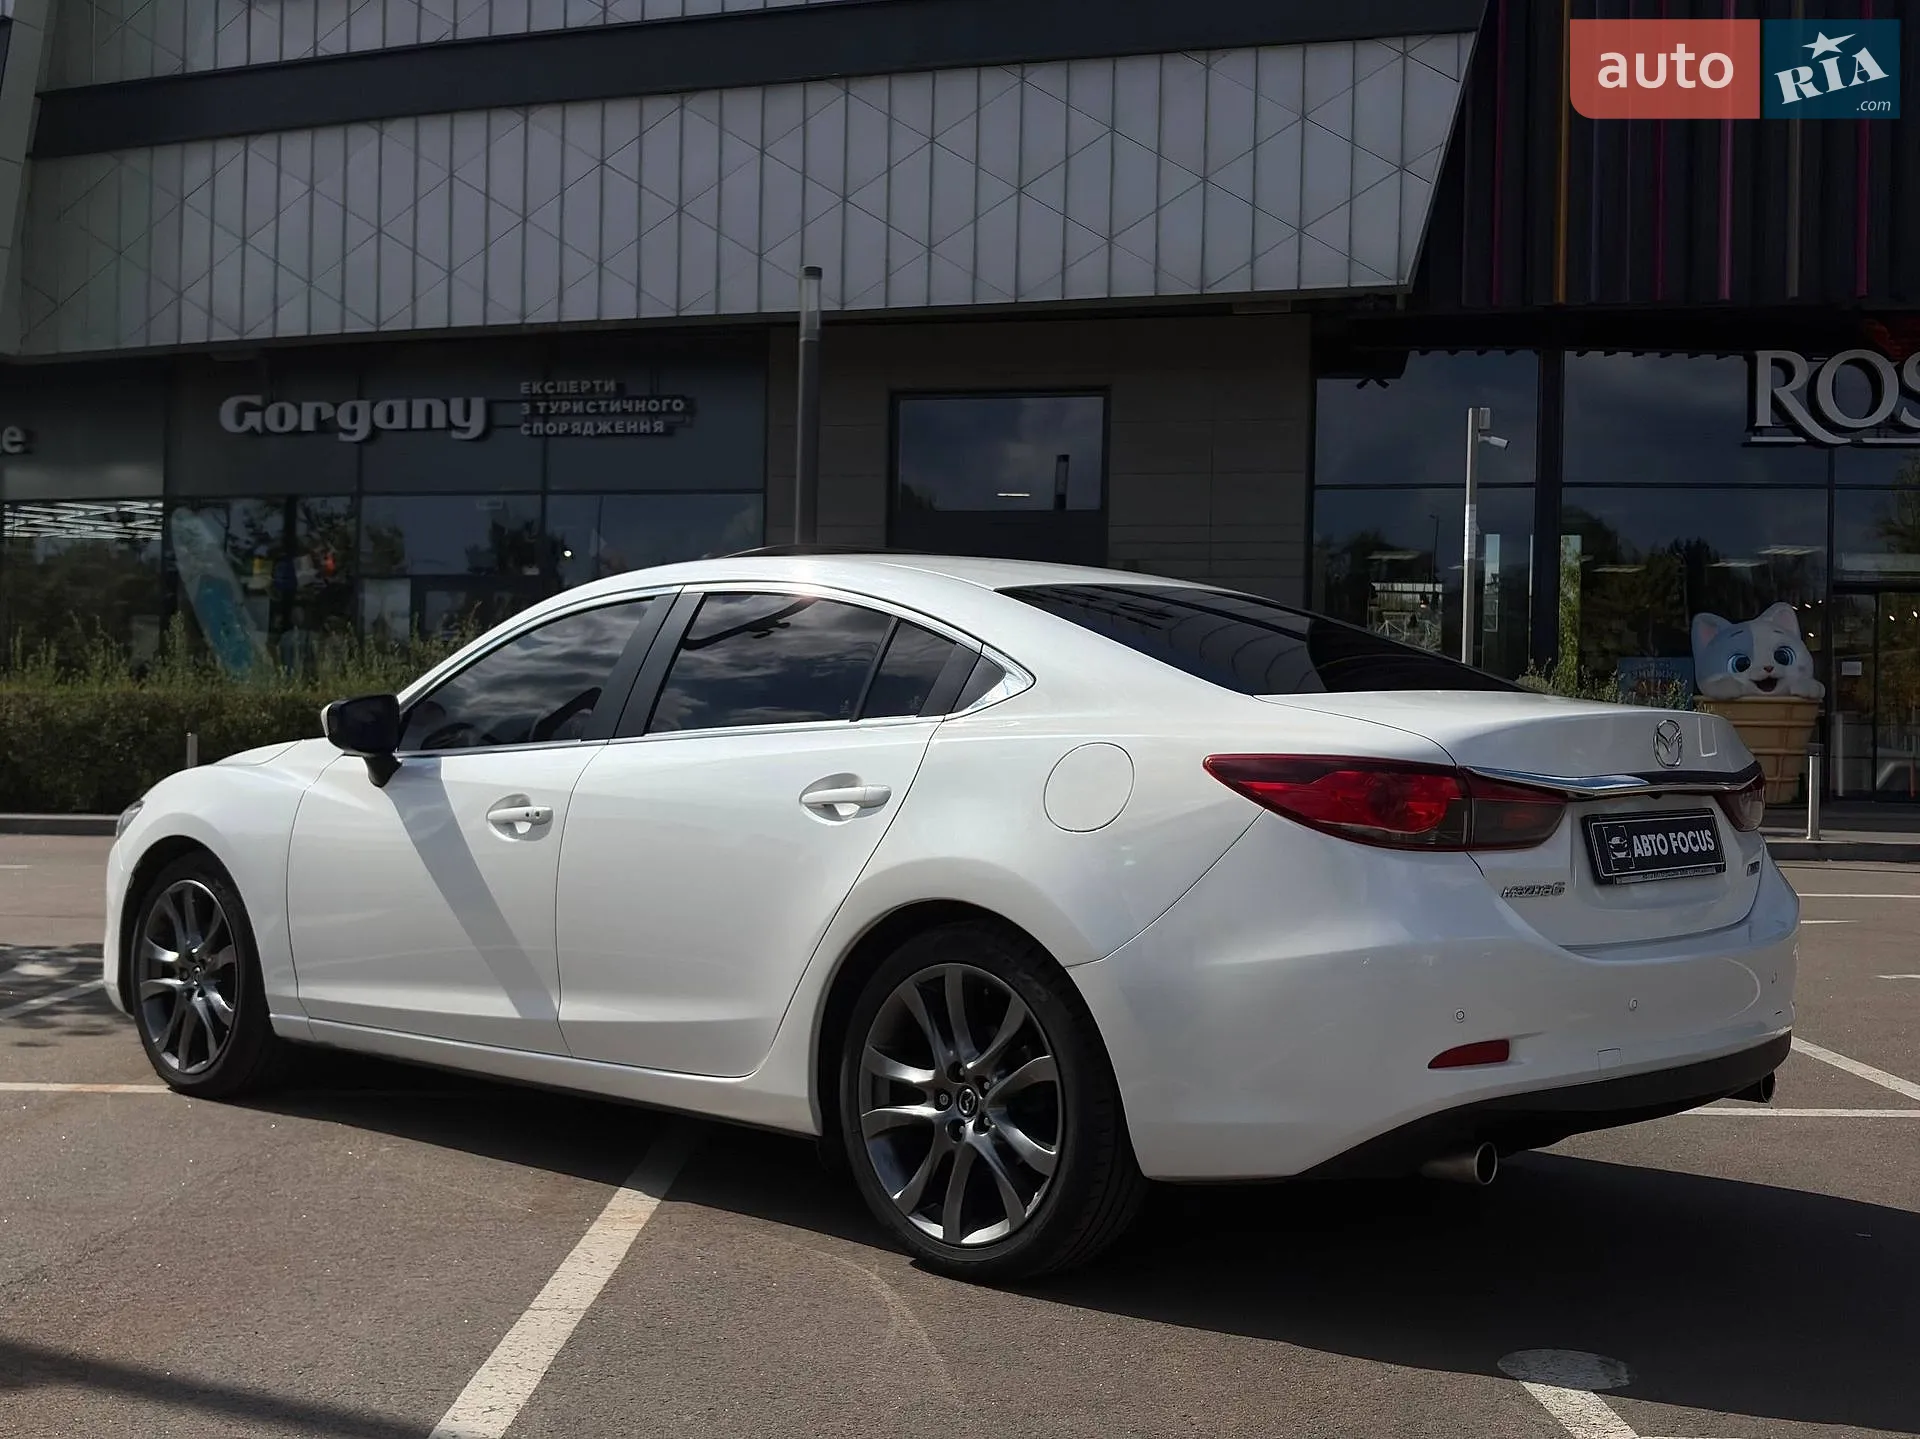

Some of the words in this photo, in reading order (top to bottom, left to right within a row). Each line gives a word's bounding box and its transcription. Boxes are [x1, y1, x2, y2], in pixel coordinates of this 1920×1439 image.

[520, 379, 617, 395] ЕКСПЕРТИ
[537, 398, 686, 415] ТУРИСТИЧНОГО
[219, 395, 486, 442] Gorgany
[520, 420, 666, 436] СПОРЯДЖЕННЯ
[1669, 830, 1715, 855] FOCUS
